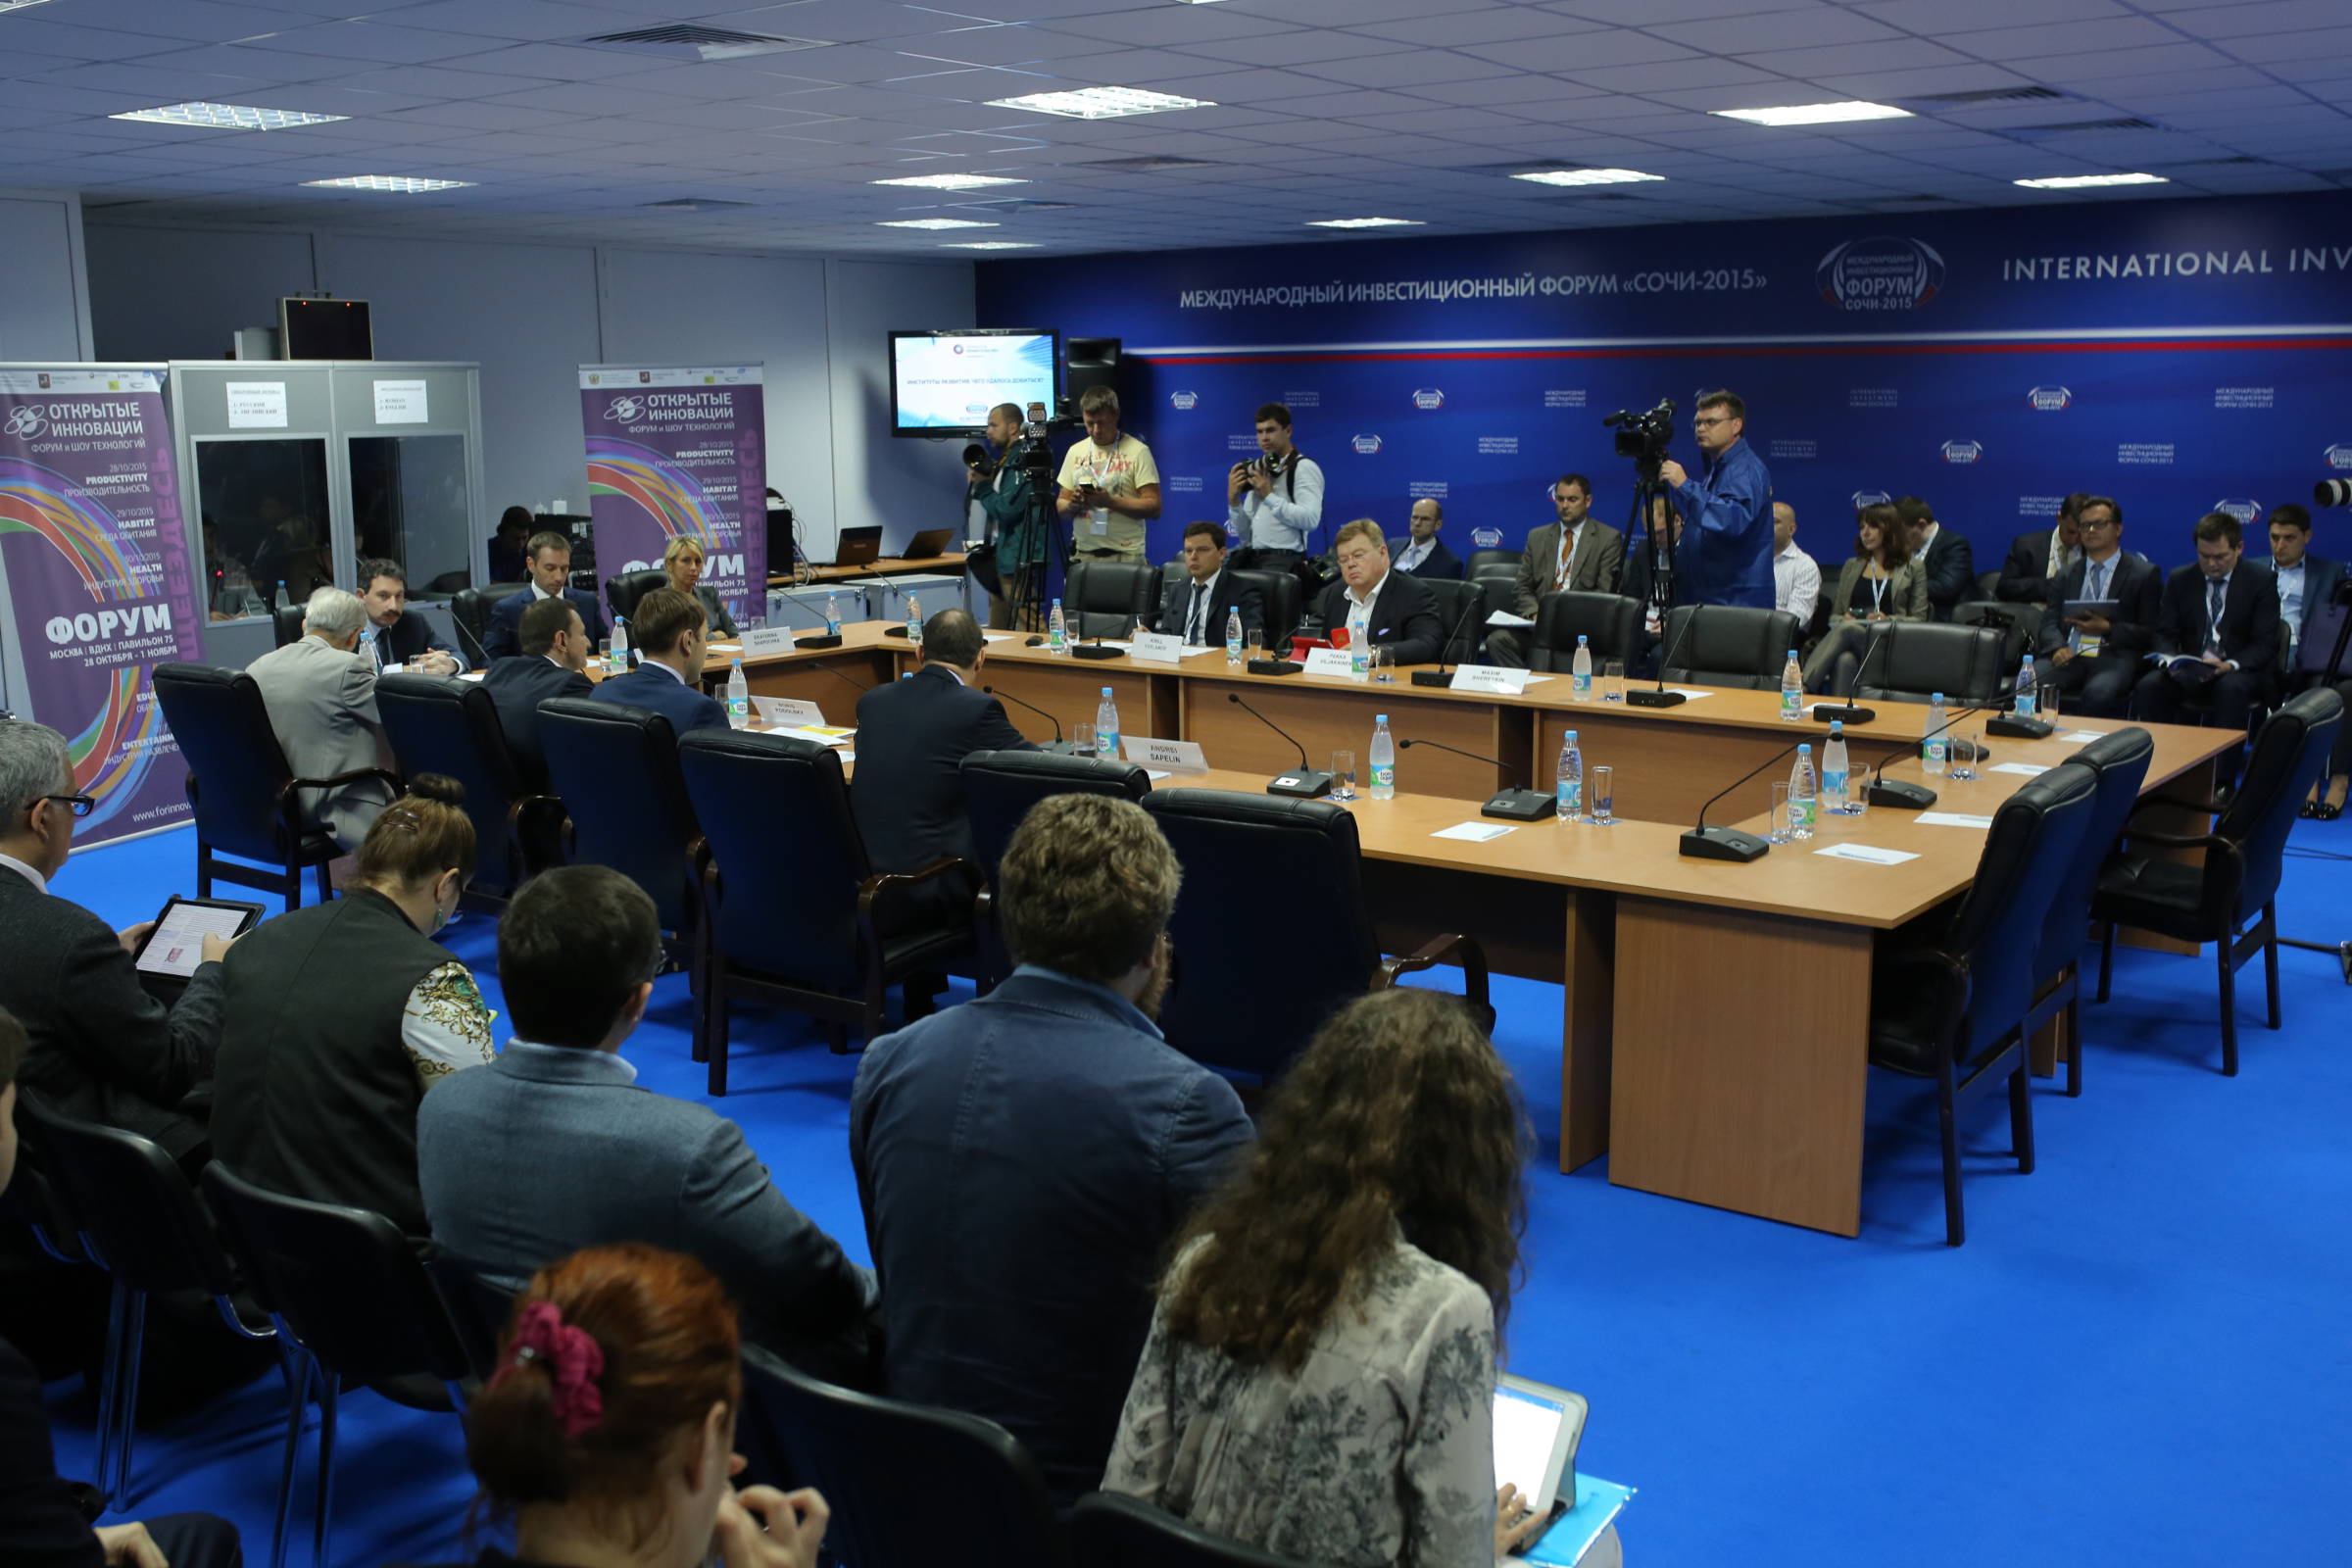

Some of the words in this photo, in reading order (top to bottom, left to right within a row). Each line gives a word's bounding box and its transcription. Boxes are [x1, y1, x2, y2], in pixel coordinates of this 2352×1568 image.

[2003, 249, 2273, 280] INTERNATIONAL
[2289, 246, 2352, 271] INV
[1180, 280, 1344, 310] МЕЖДУНАРОДНЫЙ
[1348, 272, 1536, 303] ИНВЕСТИЦИОННЫЙ
[1540, 274, 1617, 295] ФОРУМ
[1623, 269, 1767, 293] «СОЧИ-2015»
[1846, 276, 1913, 296] ФОРУМ
[1845, 297, 1912, 311] СОЧИ-2015
[648, 393, 732, 407] ОТКРЫТЫЕ
[50, 402, 141, 419] ОТКРЫТЫЕ
[649, 407, 734, 421] ИННОВАЦИИ
[52, 420, 143, 438] ИННОВАЦИИ
[628, 424, 658, 433] ФОРУМ
[665, 423, 683, 432] ШОУ
[686, 421, 735, 431] ТЕХНОЛОГИЙ
[31, 444, 63, 453] ФОРУМ
[72, 441, 90, 452] ШОУ
[93, 438, 146, 451] ТЕХНОЛОГИЙ
[676, 449, 734, 458] PRODUCTIVITY
[86, 472, 147, 484] PRODUCTIVITY
[64, 484, 150, 497] ПРОИЗВОДИТЕЛЬНОСТЬ
[118, 518, 155, 529] HABITAT
[129, 564, 162, 574] HEALTH
[718, 588, 749, 597] НОЯБРЯ
[46, 604, 172, 644] ФОРУМ
[50, 647, 83, 660] МОСКВА
[89, 642, 112, 655] ВДНХ
[119, 637, 163, 650] ПАВИЛЬОН
[165, 635, 173, 644] 75
[84, 657, 94, 666] 28
[95, 652, 133, 665] ОКТЯБРЯ
[147, 645, 177, 658] НОЯБРЯ
[122, 733, 174, 751] ENTERTAINM
[145, 744, 179, 757] РАЗВЛЕЧЕ
[1150, 753, 1181, 763] SAPELIN
[132, 802, 192, 822] www.forinnov
